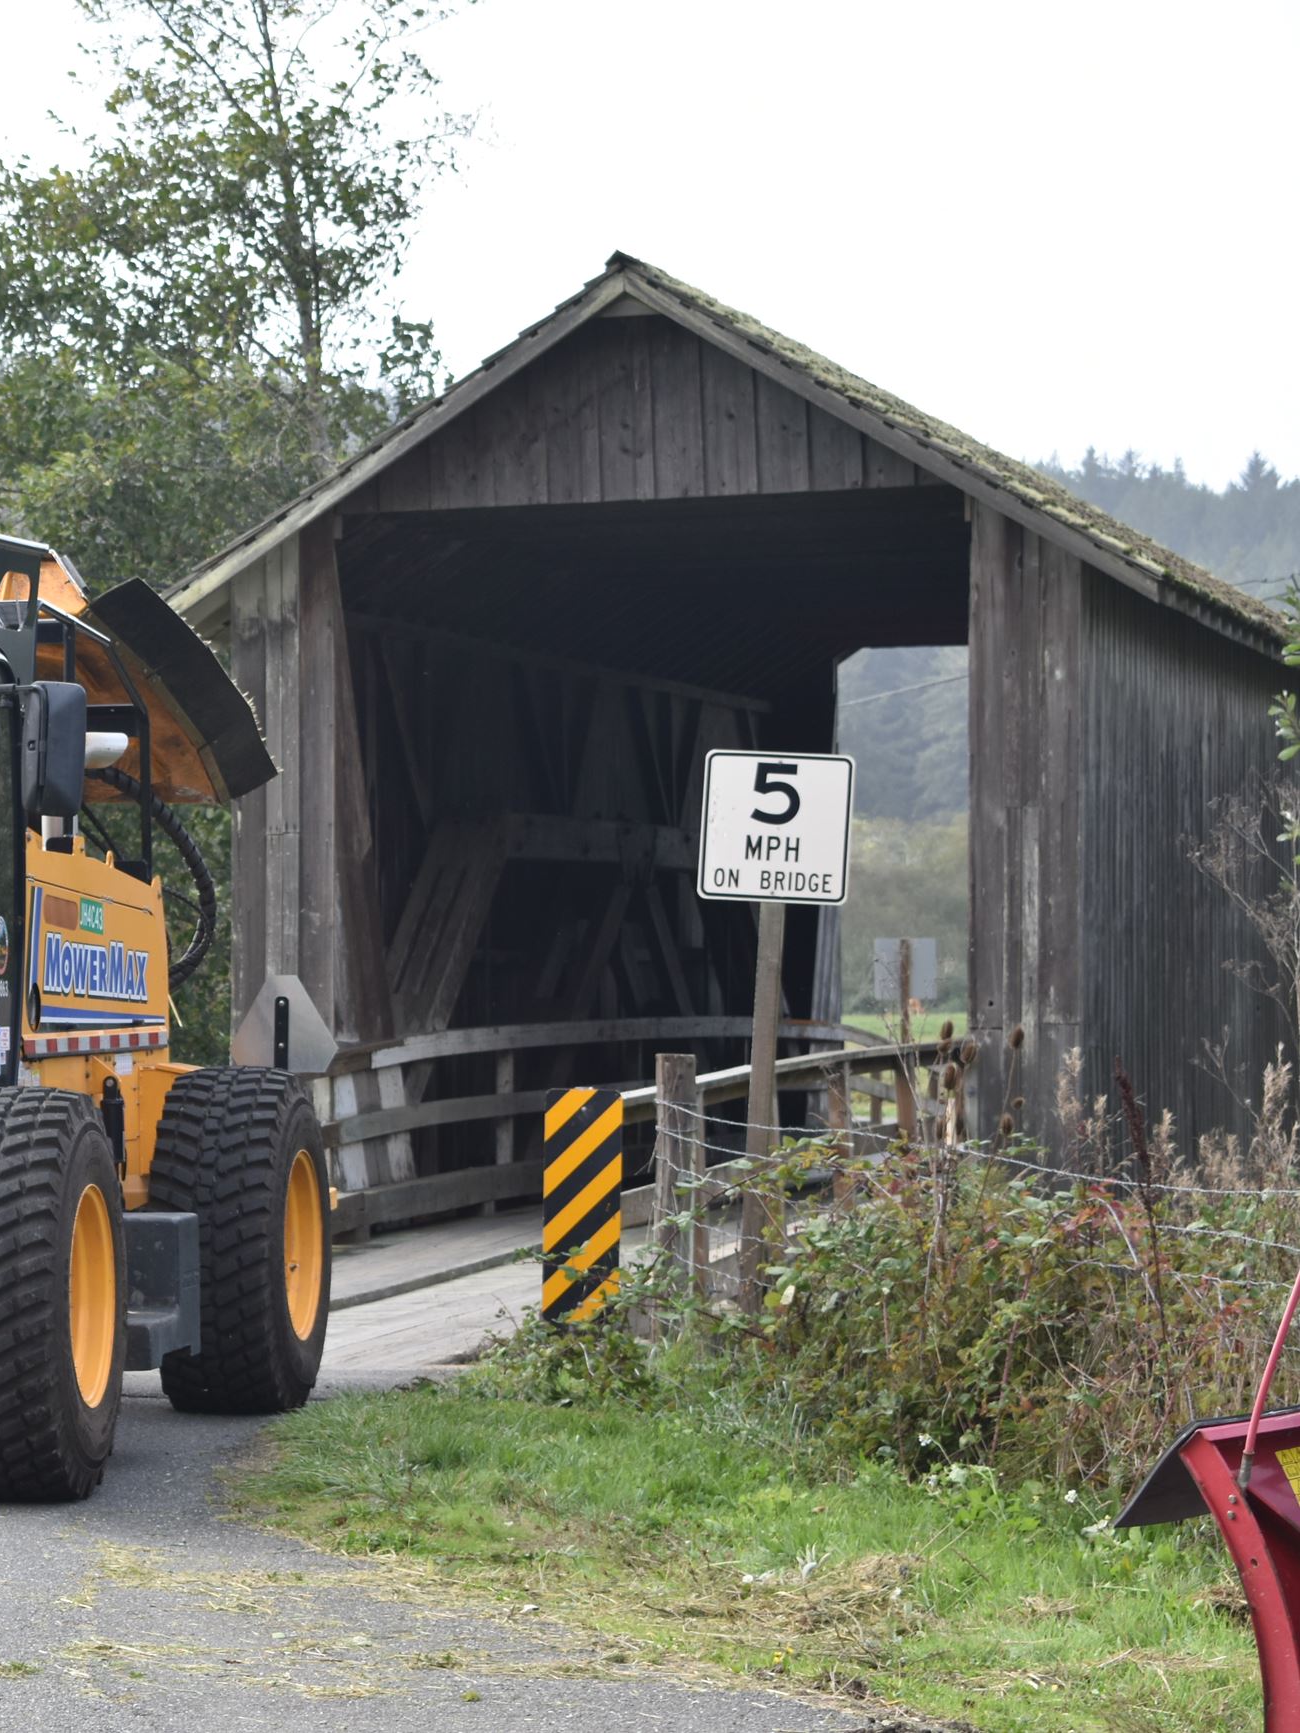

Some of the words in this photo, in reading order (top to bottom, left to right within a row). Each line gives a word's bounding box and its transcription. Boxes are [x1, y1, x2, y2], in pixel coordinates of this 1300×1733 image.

[750, 762, 801, 825] 5
[745, 835, 800, 862] MPH
[714, 868, 740, 888] ON
[760, 870, 833, 893] BRIDGE
